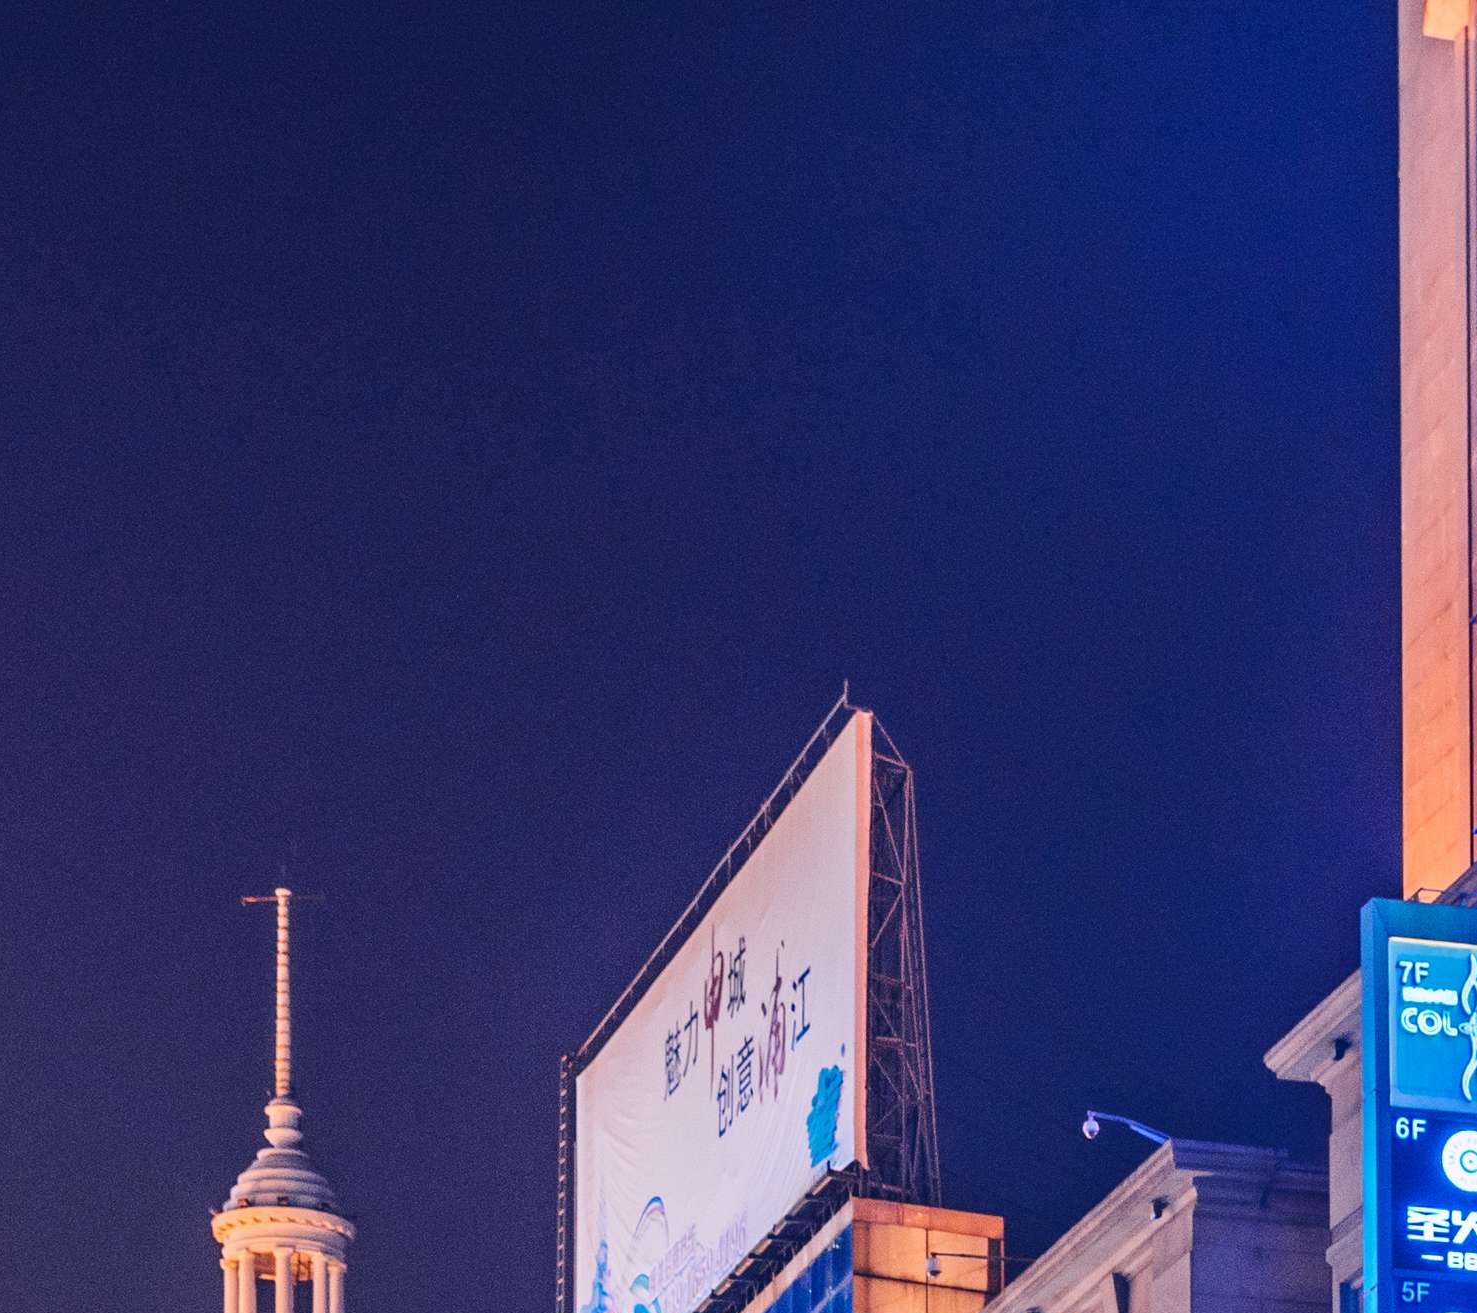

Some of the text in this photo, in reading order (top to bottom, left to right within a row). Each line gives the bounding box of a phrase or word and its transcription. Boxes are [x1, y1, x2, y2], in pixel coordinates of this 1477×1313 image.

[1398, 960, 1430, 985] 7F
[1395, 1117, 1427, 1141] 6F
[1401, 1281, 1430, 1303] 5F
